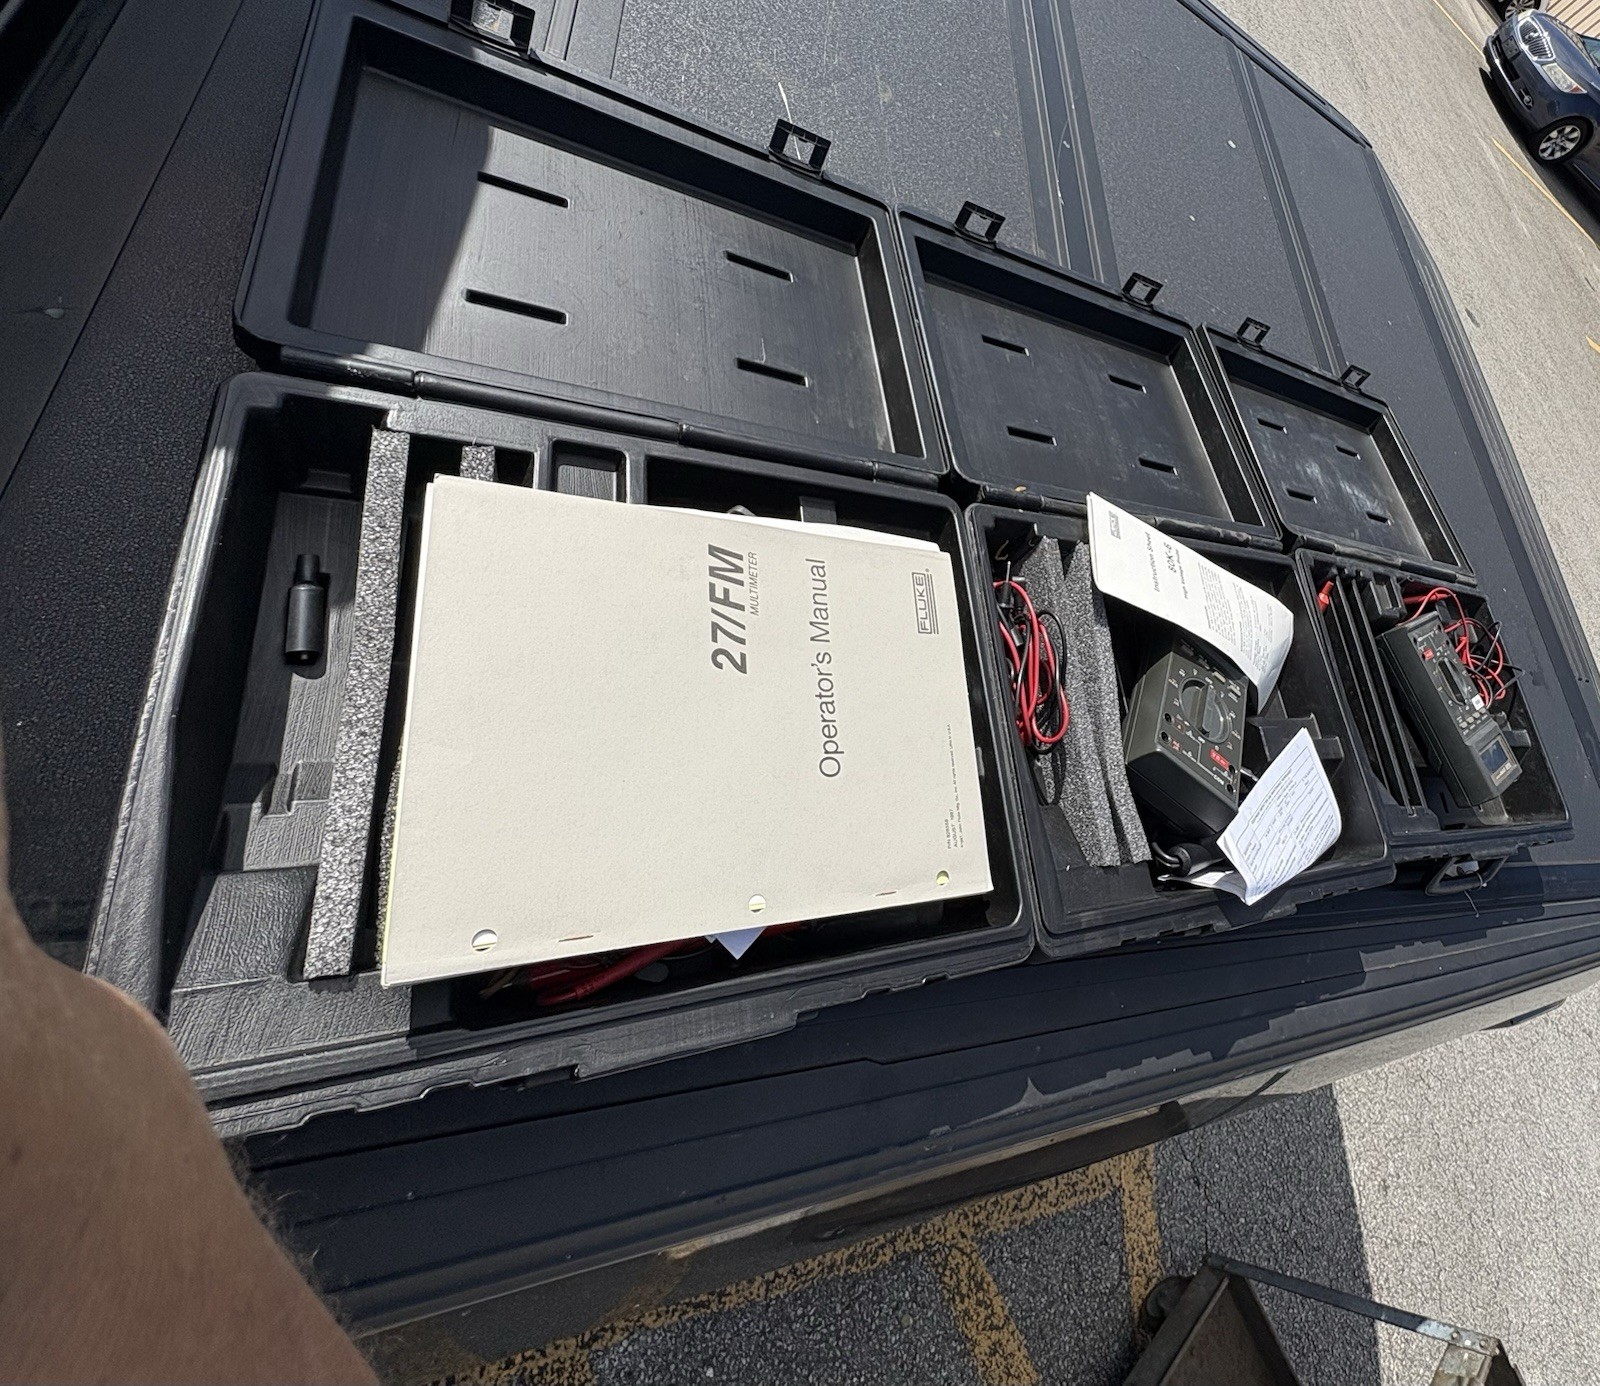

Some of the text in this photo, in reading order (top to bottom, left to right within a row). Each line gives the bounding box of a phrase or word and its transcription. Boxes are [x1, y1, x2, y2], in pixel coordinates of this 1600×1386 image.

[748, 551, 760, 616] MULTIMETER
[1144, 530, 1160, 593] Instruction Sheet
[708, 544, 748, 674] 27/FM
[912, 573, 933, 633] FLUKE
[805, 558, 844, 778] Operator's Manual
